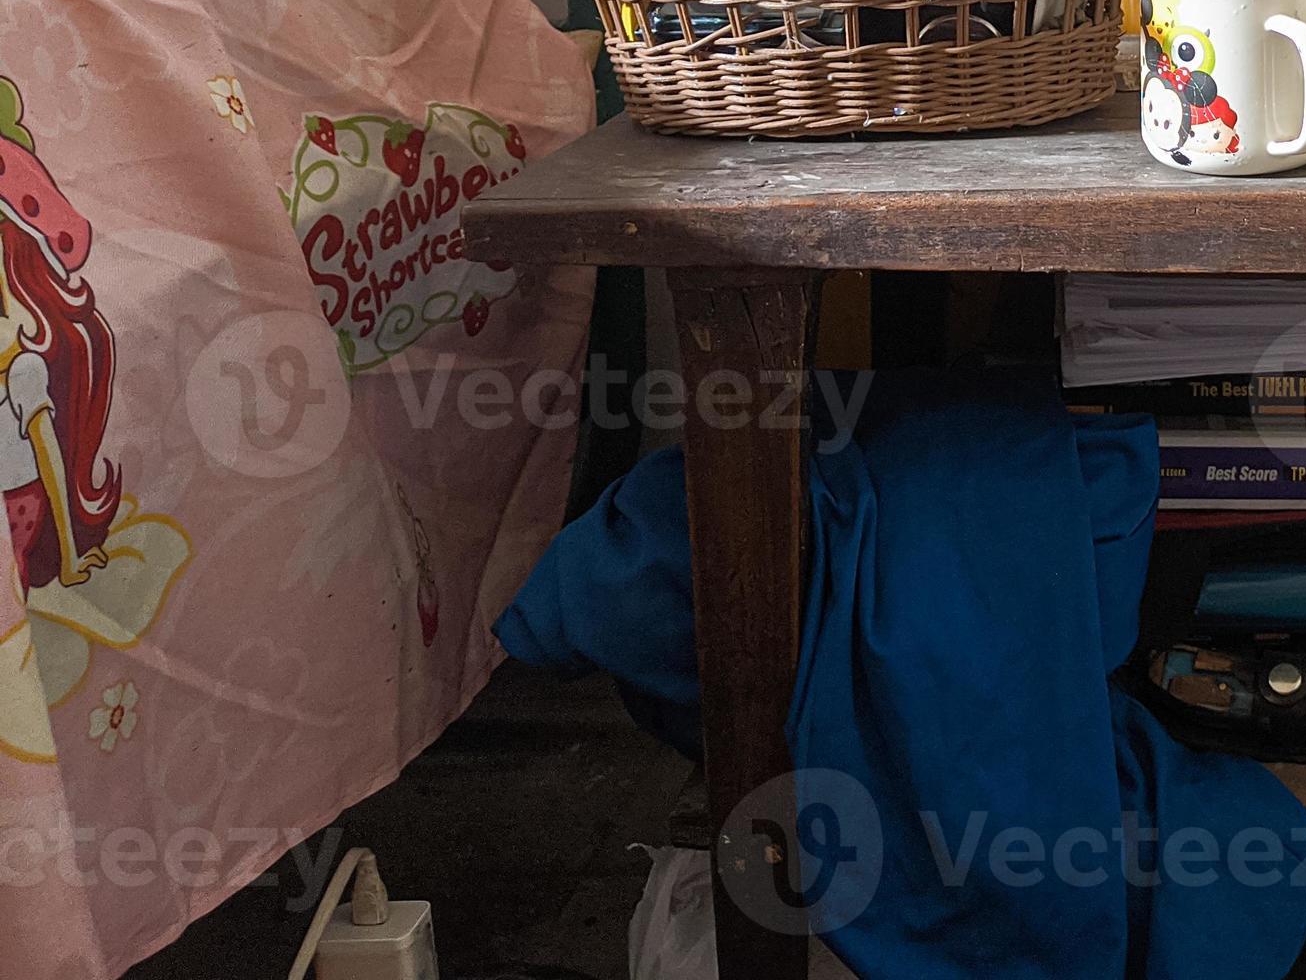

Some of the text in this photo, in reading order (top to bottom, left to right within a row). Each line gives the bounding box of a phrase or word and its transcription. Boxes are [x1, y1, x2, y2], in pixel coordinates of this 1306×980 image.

[301, 154, 520, 327] Strawbe
[1190, 381, 1218, 397] The
[1222, 380, 1254, 397] Best
[1206, 465, 1236, 481] Best
[1240, 465, 1278, 481] Score
